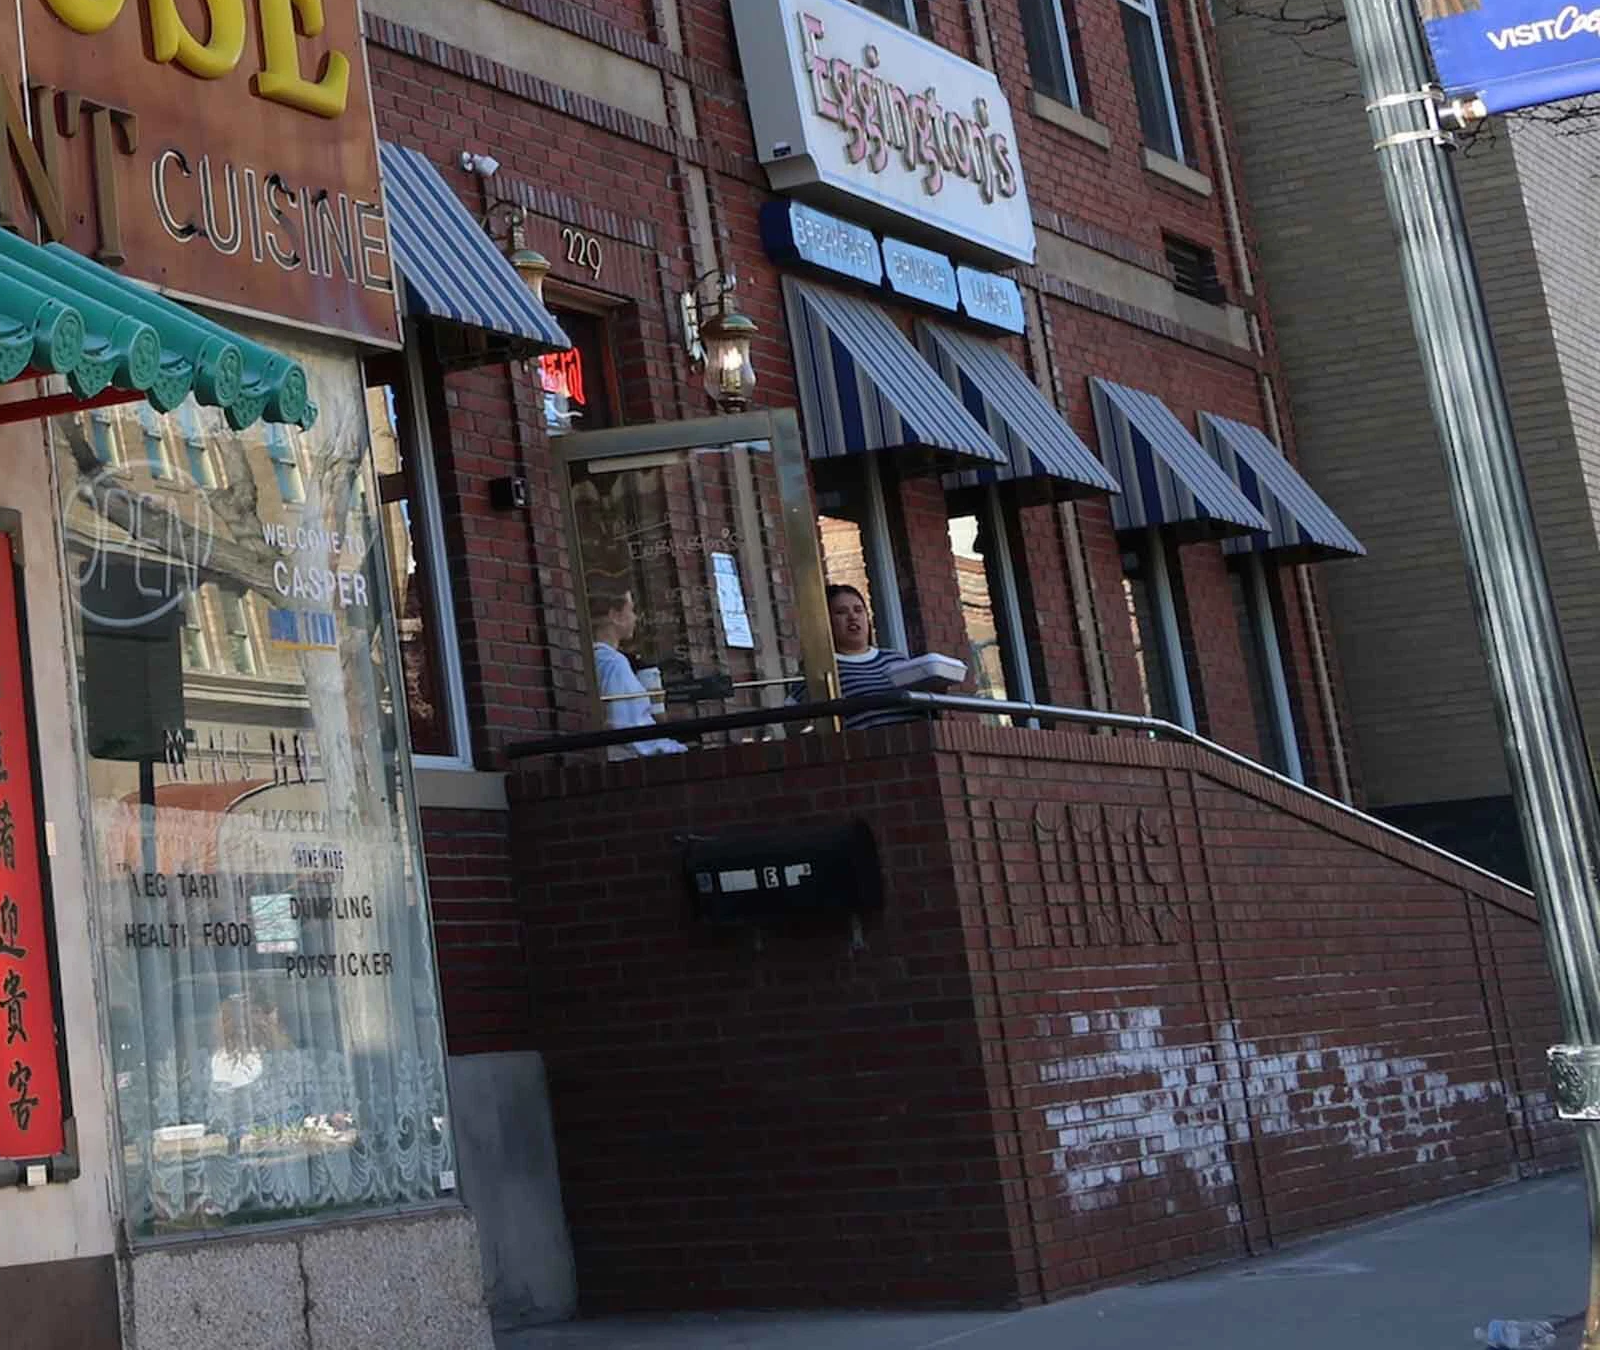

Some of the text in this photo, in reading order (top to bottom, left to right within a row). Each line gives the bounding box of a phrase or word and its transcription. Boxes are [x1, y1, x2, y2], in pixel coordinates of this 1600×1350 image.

[151, 147, 392, 292] CUISINE
[563, 228, 603, 281] 229
[64, 483, 200, 597] OPEN
[261, 522, 367, 557] WELCOME TO
[273, 560, 369, 607] CASPER
[203, 922, 252, 947] FOOD
[286, 953, 395, 978] POTSTICKER
